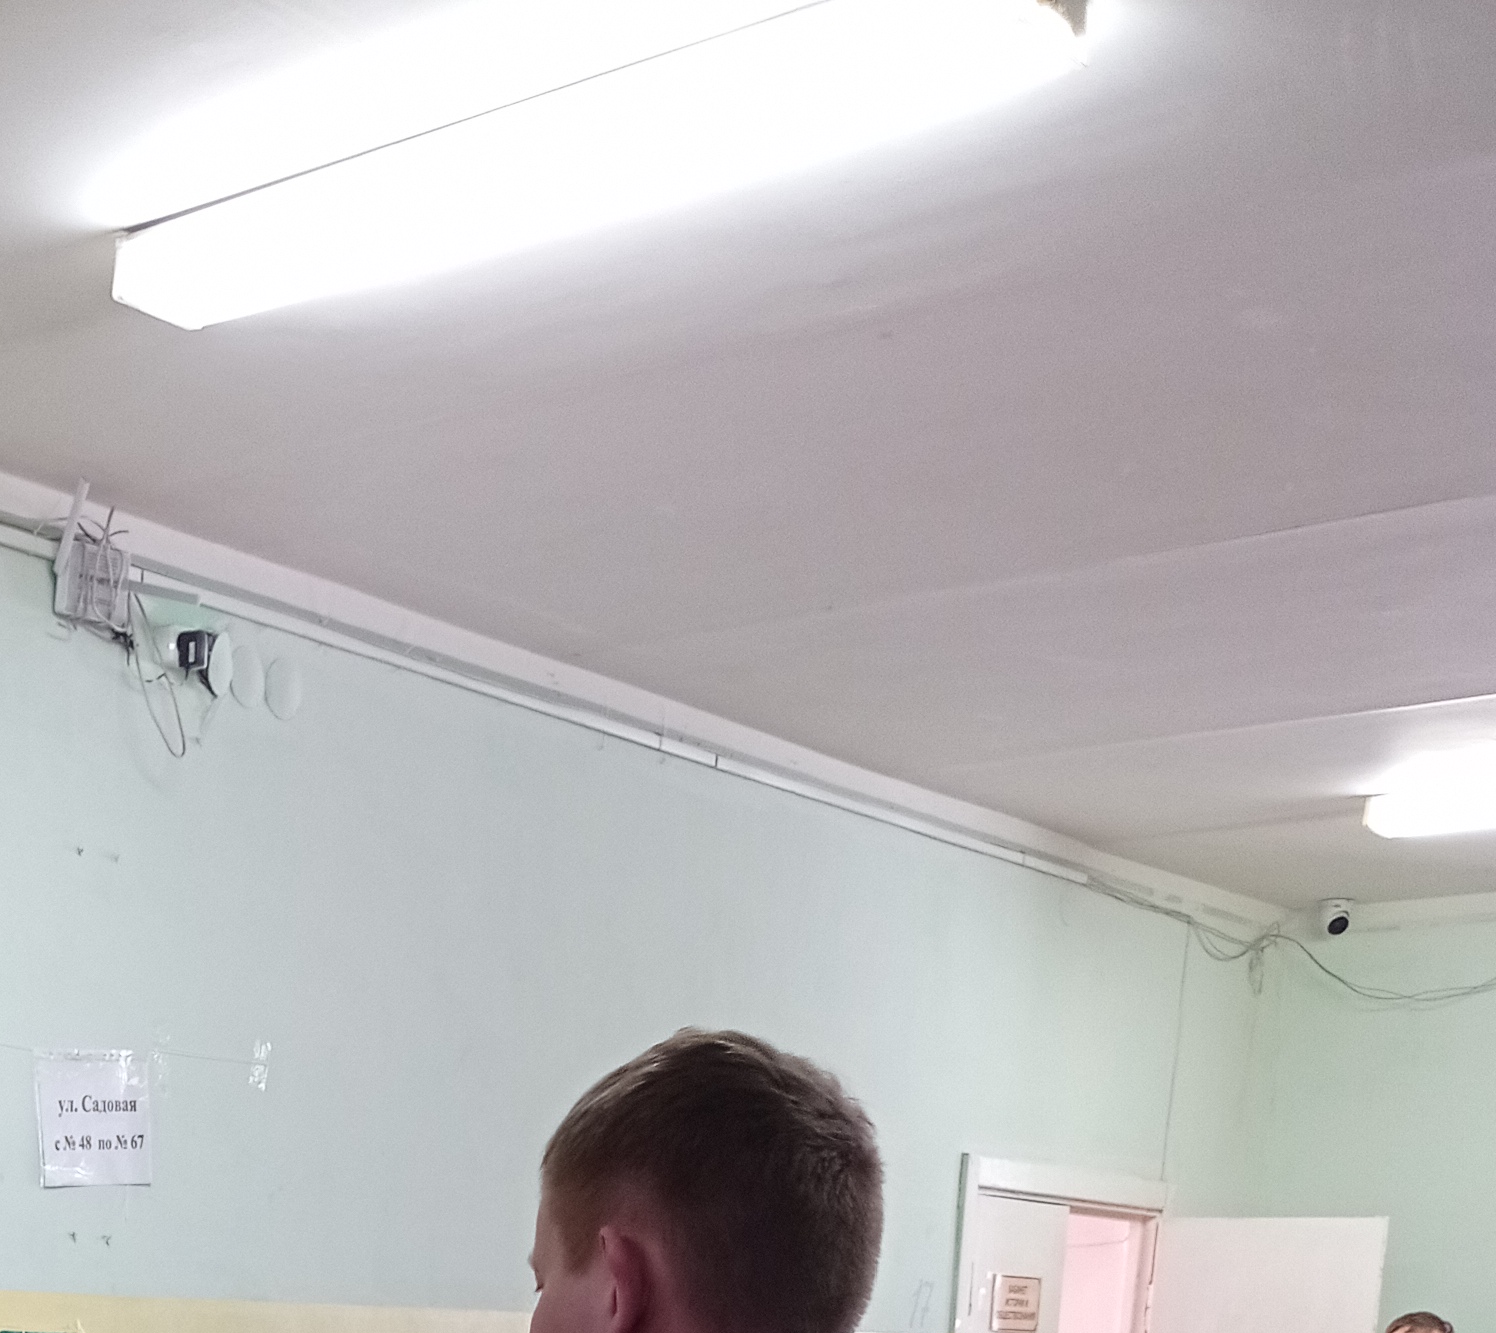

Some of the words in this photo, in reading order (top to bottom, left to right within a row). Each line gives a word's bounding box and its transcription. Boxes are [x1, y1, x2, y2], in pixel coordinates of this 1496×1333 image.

[58, 1099, 78, 1118] ул.
[81, 1094, 137, 1114] Садовая
[54, 1139, 60, 1151] с
[78, 1134, 92, 1151] 48
[98, 1139, 112, 1151] по
[130, 1134, 145, 1150] 67
